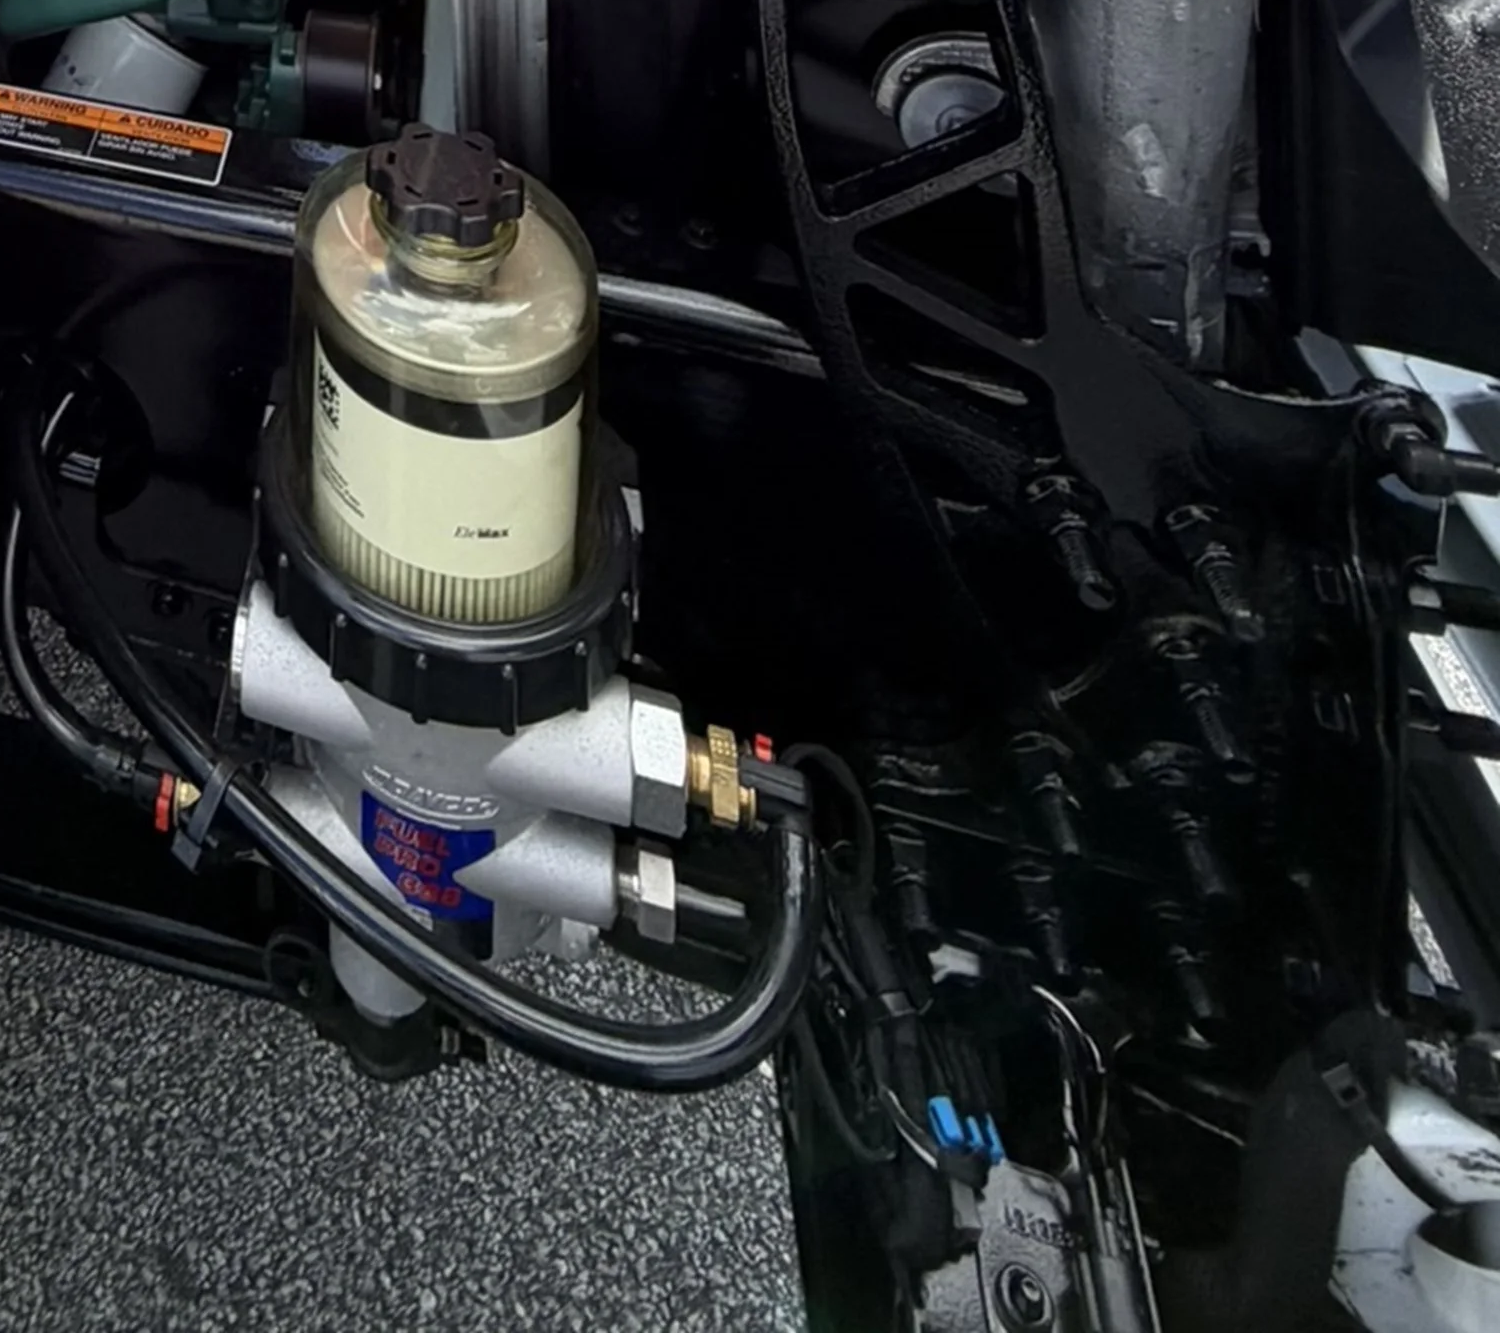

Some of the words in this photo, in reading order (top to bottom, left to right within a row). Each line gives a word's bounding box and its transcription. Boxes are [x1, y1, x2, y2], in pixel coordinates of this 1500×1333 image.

[14, 91, 87, 116] WARNING
[135, 115, 210, 138] CUIDADO
[374, 808, 450, 857] FUEL
[374, 831, 440, 877] PRO
